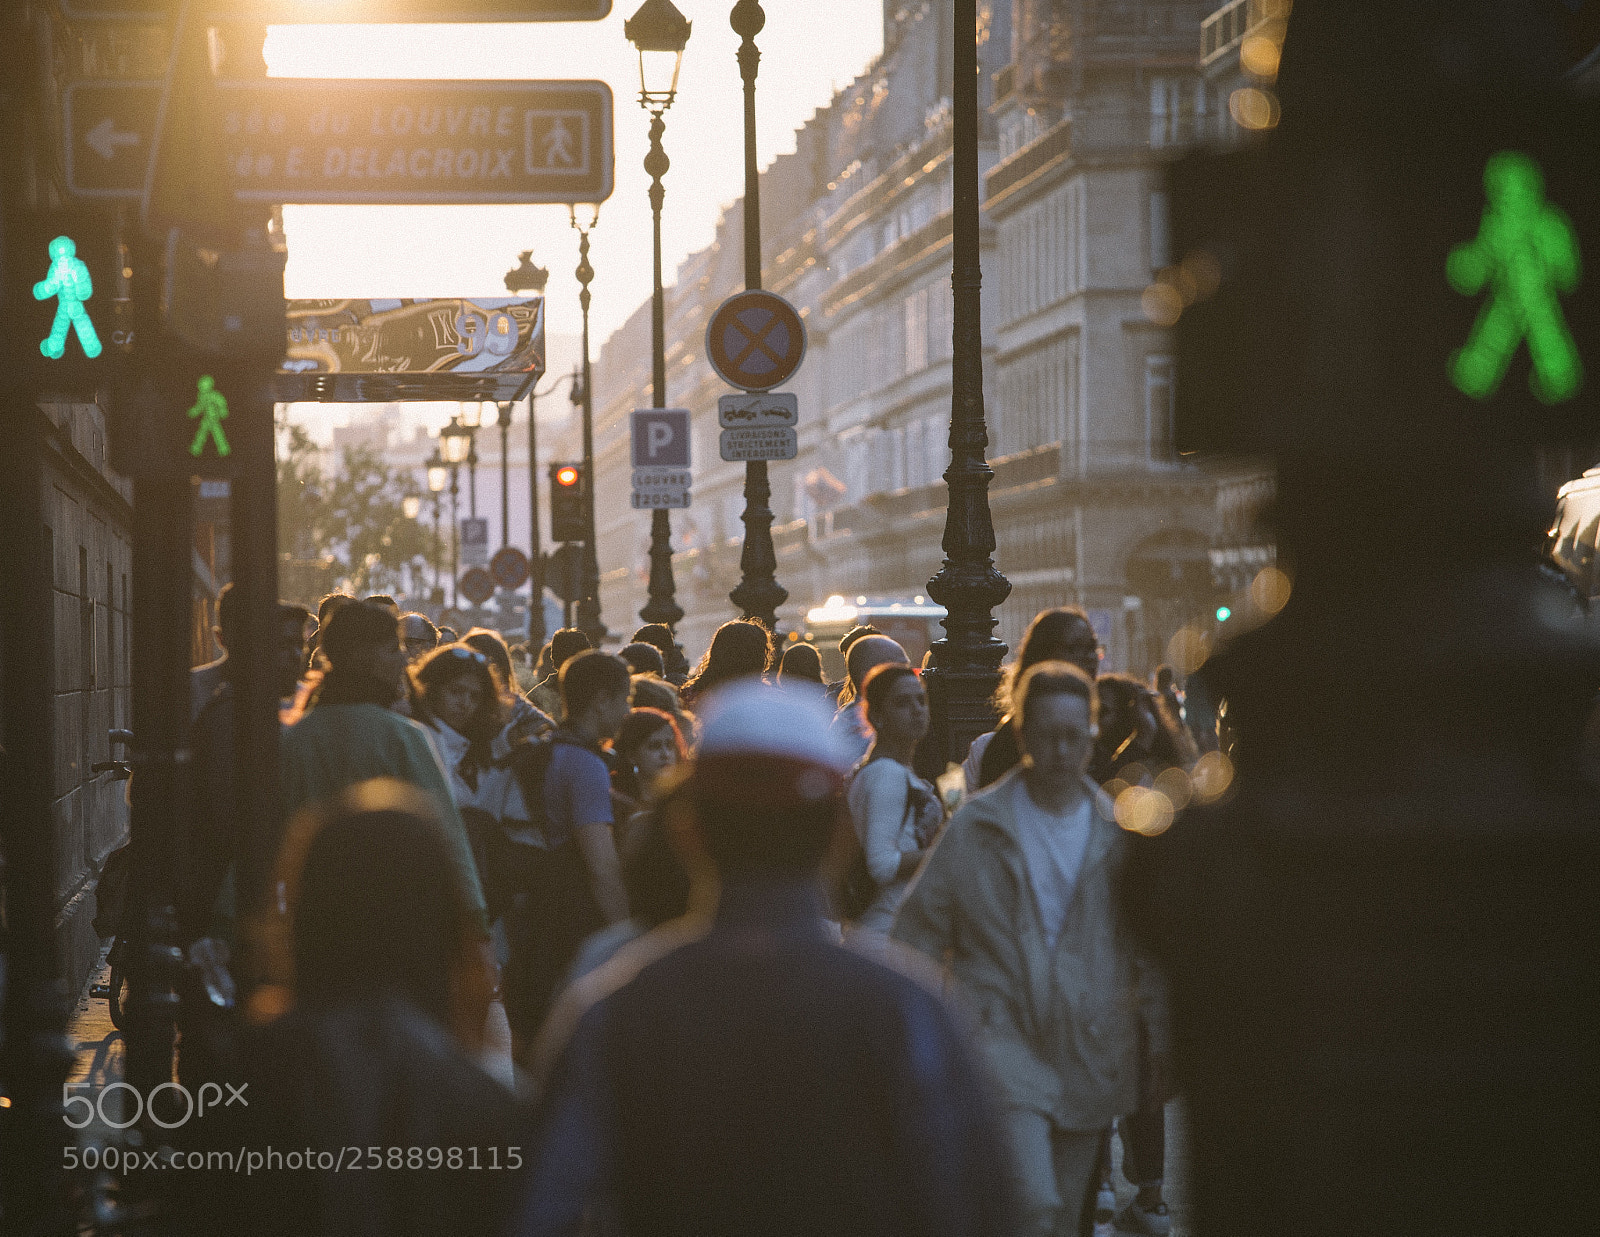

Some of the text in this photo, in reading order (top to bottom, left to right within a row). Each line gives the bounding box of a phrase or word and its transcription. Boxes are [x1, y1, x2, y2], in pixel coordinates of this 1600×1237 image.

[309, 105, 351, 135] du
[370, 105, 514, 136] LOUVRE
[323, 147, 517, 179] DELACROIX
[290, 329, 340, 343] UVRE
[456, 313, 519, 356] 99
[648, 421, 673, 458] P
[730, 430, 786, 440] LIVRAISONS
[727, 439, 791, 449] STRICTEMENT
[731, 449, 786, 458] INTERDITES
[637, 474, 686, 486] LOUVRE
